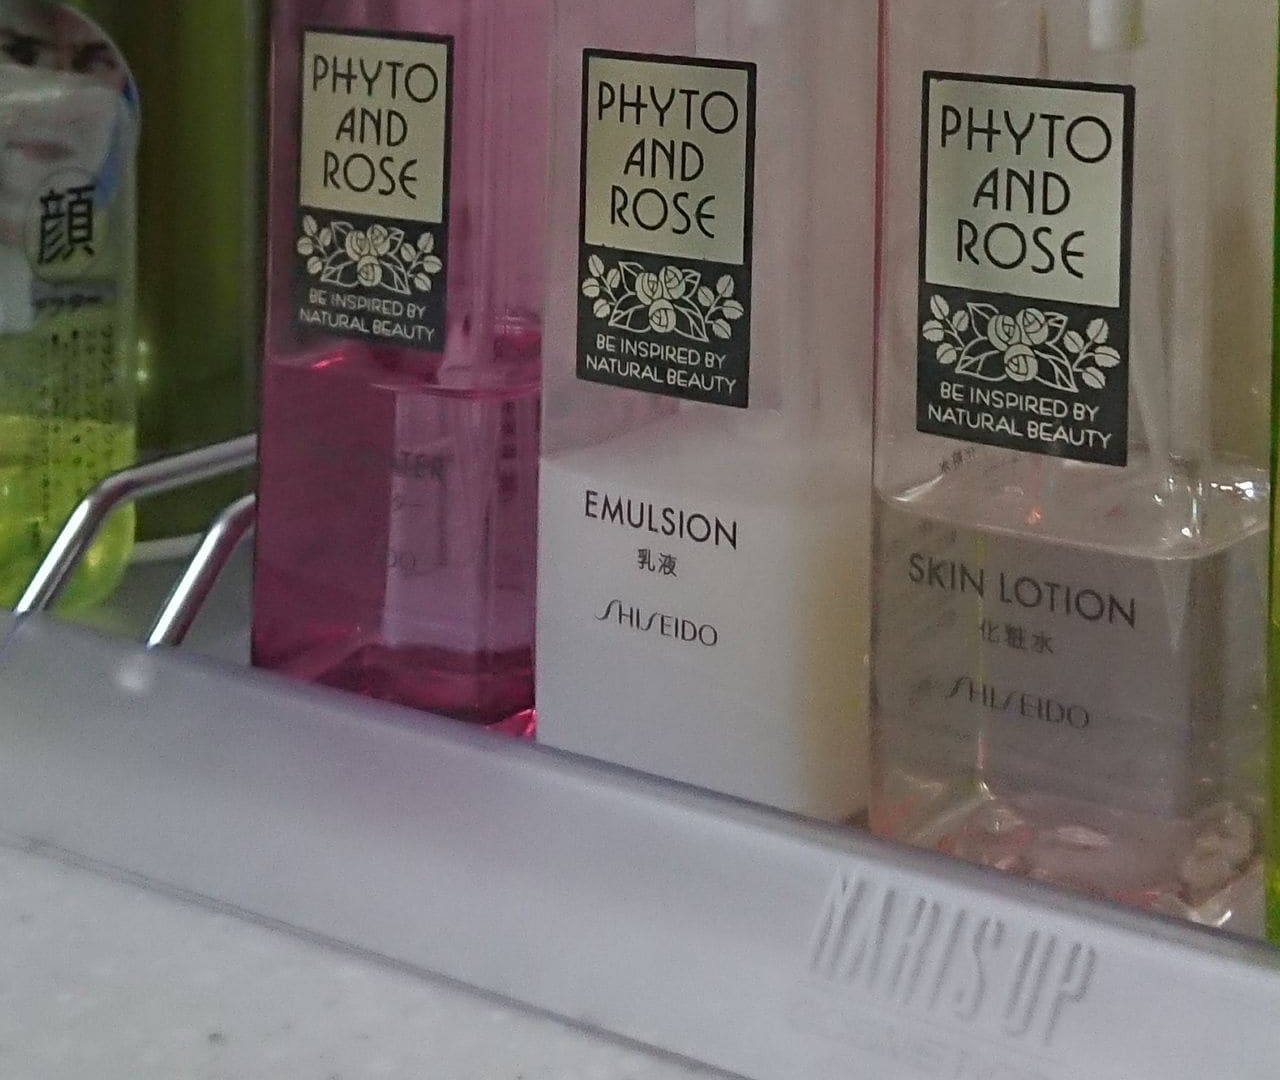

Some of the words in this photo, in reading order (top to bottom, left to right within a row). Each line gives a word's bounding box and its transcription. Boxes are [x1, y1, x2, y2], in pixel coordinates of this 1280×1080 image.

[312, 54, 438, 103] PHYTO
[335, 107, 408, 147] AND
[598, 81, 739, 134] PHYTO
[941, 105, 1112, 163] PHYTO
[322, 150, 417, 200] ROSE
[623, 138, 705, 182] AND
[610, 185, 716, 239] ROSE
[972, 167, 1070, 215] AND
[37, 183, 96, 265] 顔
[956, 218, 1085, 279] ROSE
[299, 308, 369, 333] NATURAL
[372, 316, 436, 343] BEAUTY
[308, 287, 328, 306] BE
[331, 291, 403, 315] INSPIRED
[406, 303, 427, 320] BY
[586, 354, 664, 384] NATURAL
[666, 367, 737, 395] BEAUTY
[597, 334, 616, 353] BE
[619, 338, 701, 367] INSPIRED
[704, 352, 728, 370] BY
[928, 403, 1023, 437] NATURAL
[1026, 422, 1112, 449] BEAUTY
[940, 382, 964, 402] BE
[969, 387, 1069, 417] INSPIRED
[1073, 402, 1100, 422] BY
[585, 490, 737, 550] EMULSION
[637, 548, 677, 578] 乳液
[909, 553, 985, 597] SKIN
[999, 572, 1136, 629] LOTION
[595, 599, 718, 646] SHISEIDO
[946, 677, 1090, 729] SHISEIDO
